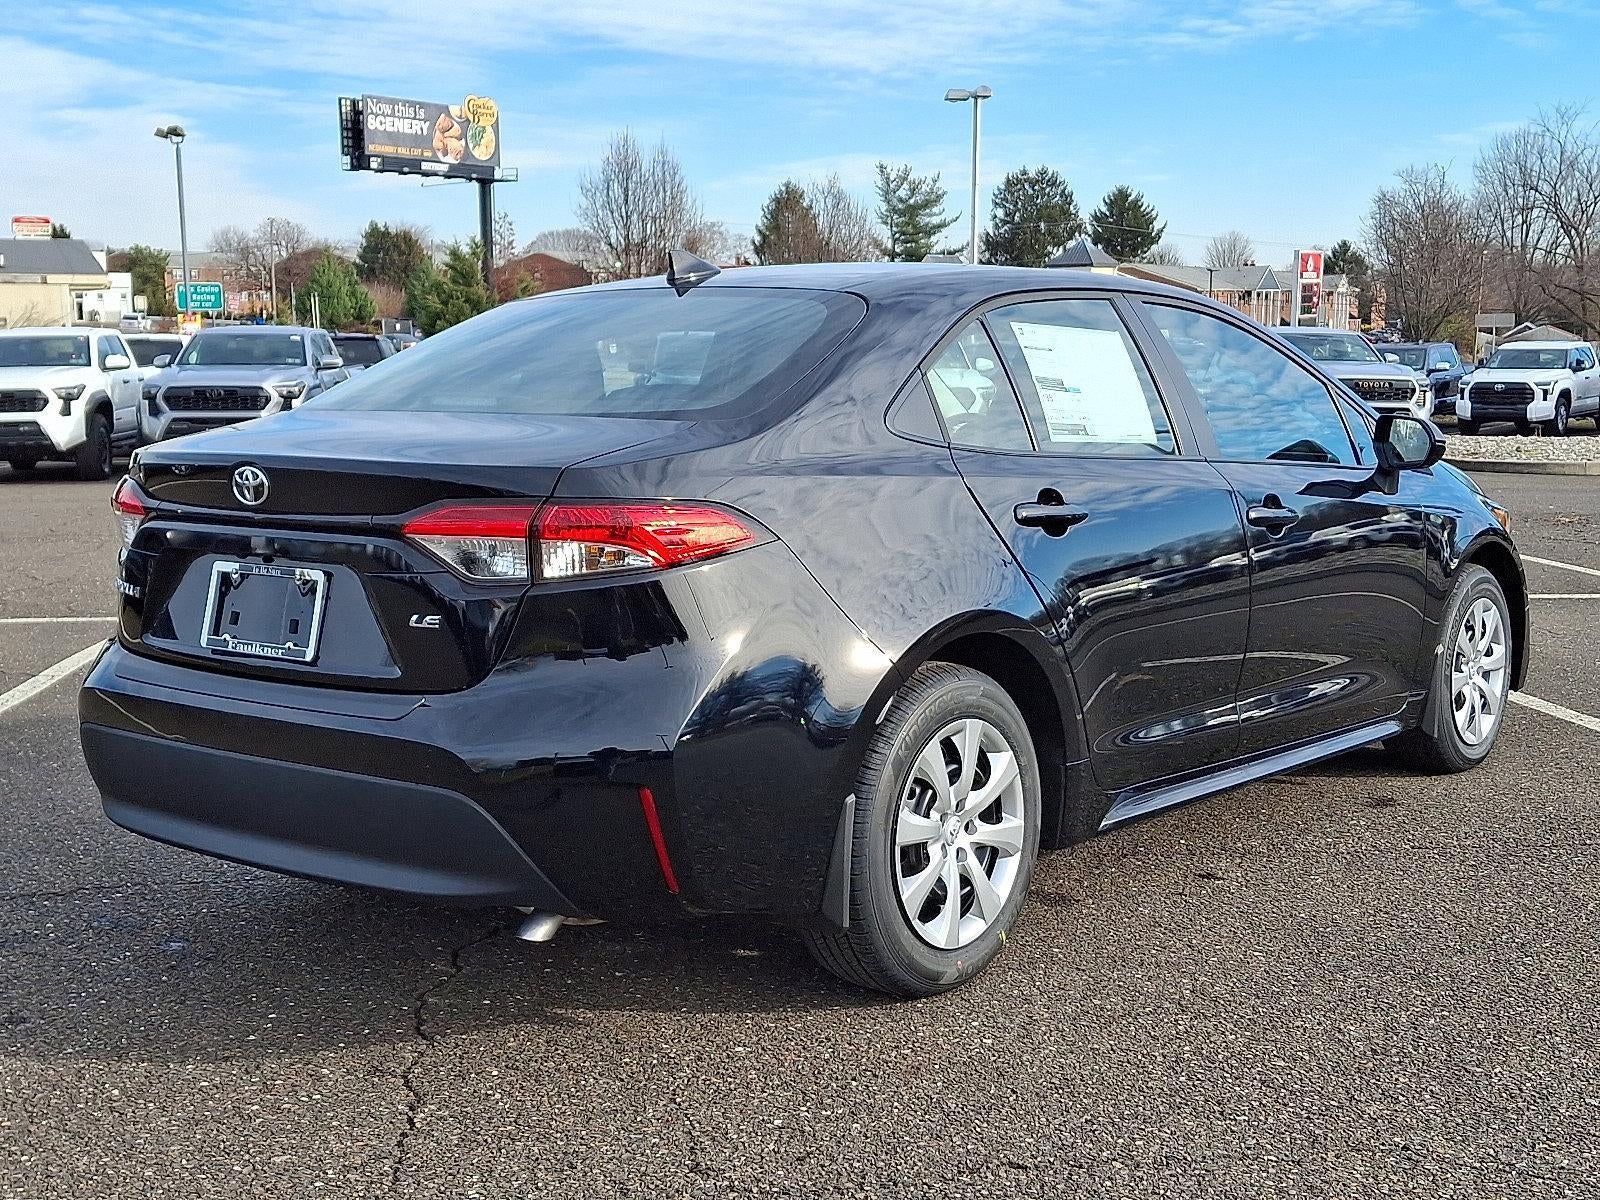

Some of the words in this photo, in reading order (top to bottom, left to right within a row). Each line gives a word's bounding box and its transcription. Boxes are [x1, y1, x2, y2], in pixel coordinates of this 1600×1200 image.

[367, 98, 393, 116] Now
[394, 101, 415, 118] this
[367, 114, 430, 136] SCENERY
[196, 285, 219, 293] Casino
[192, 293, 215, 302] Racing
[409, 614, 441, 629] LE
[228, 640, 286, 656] Faulkner
